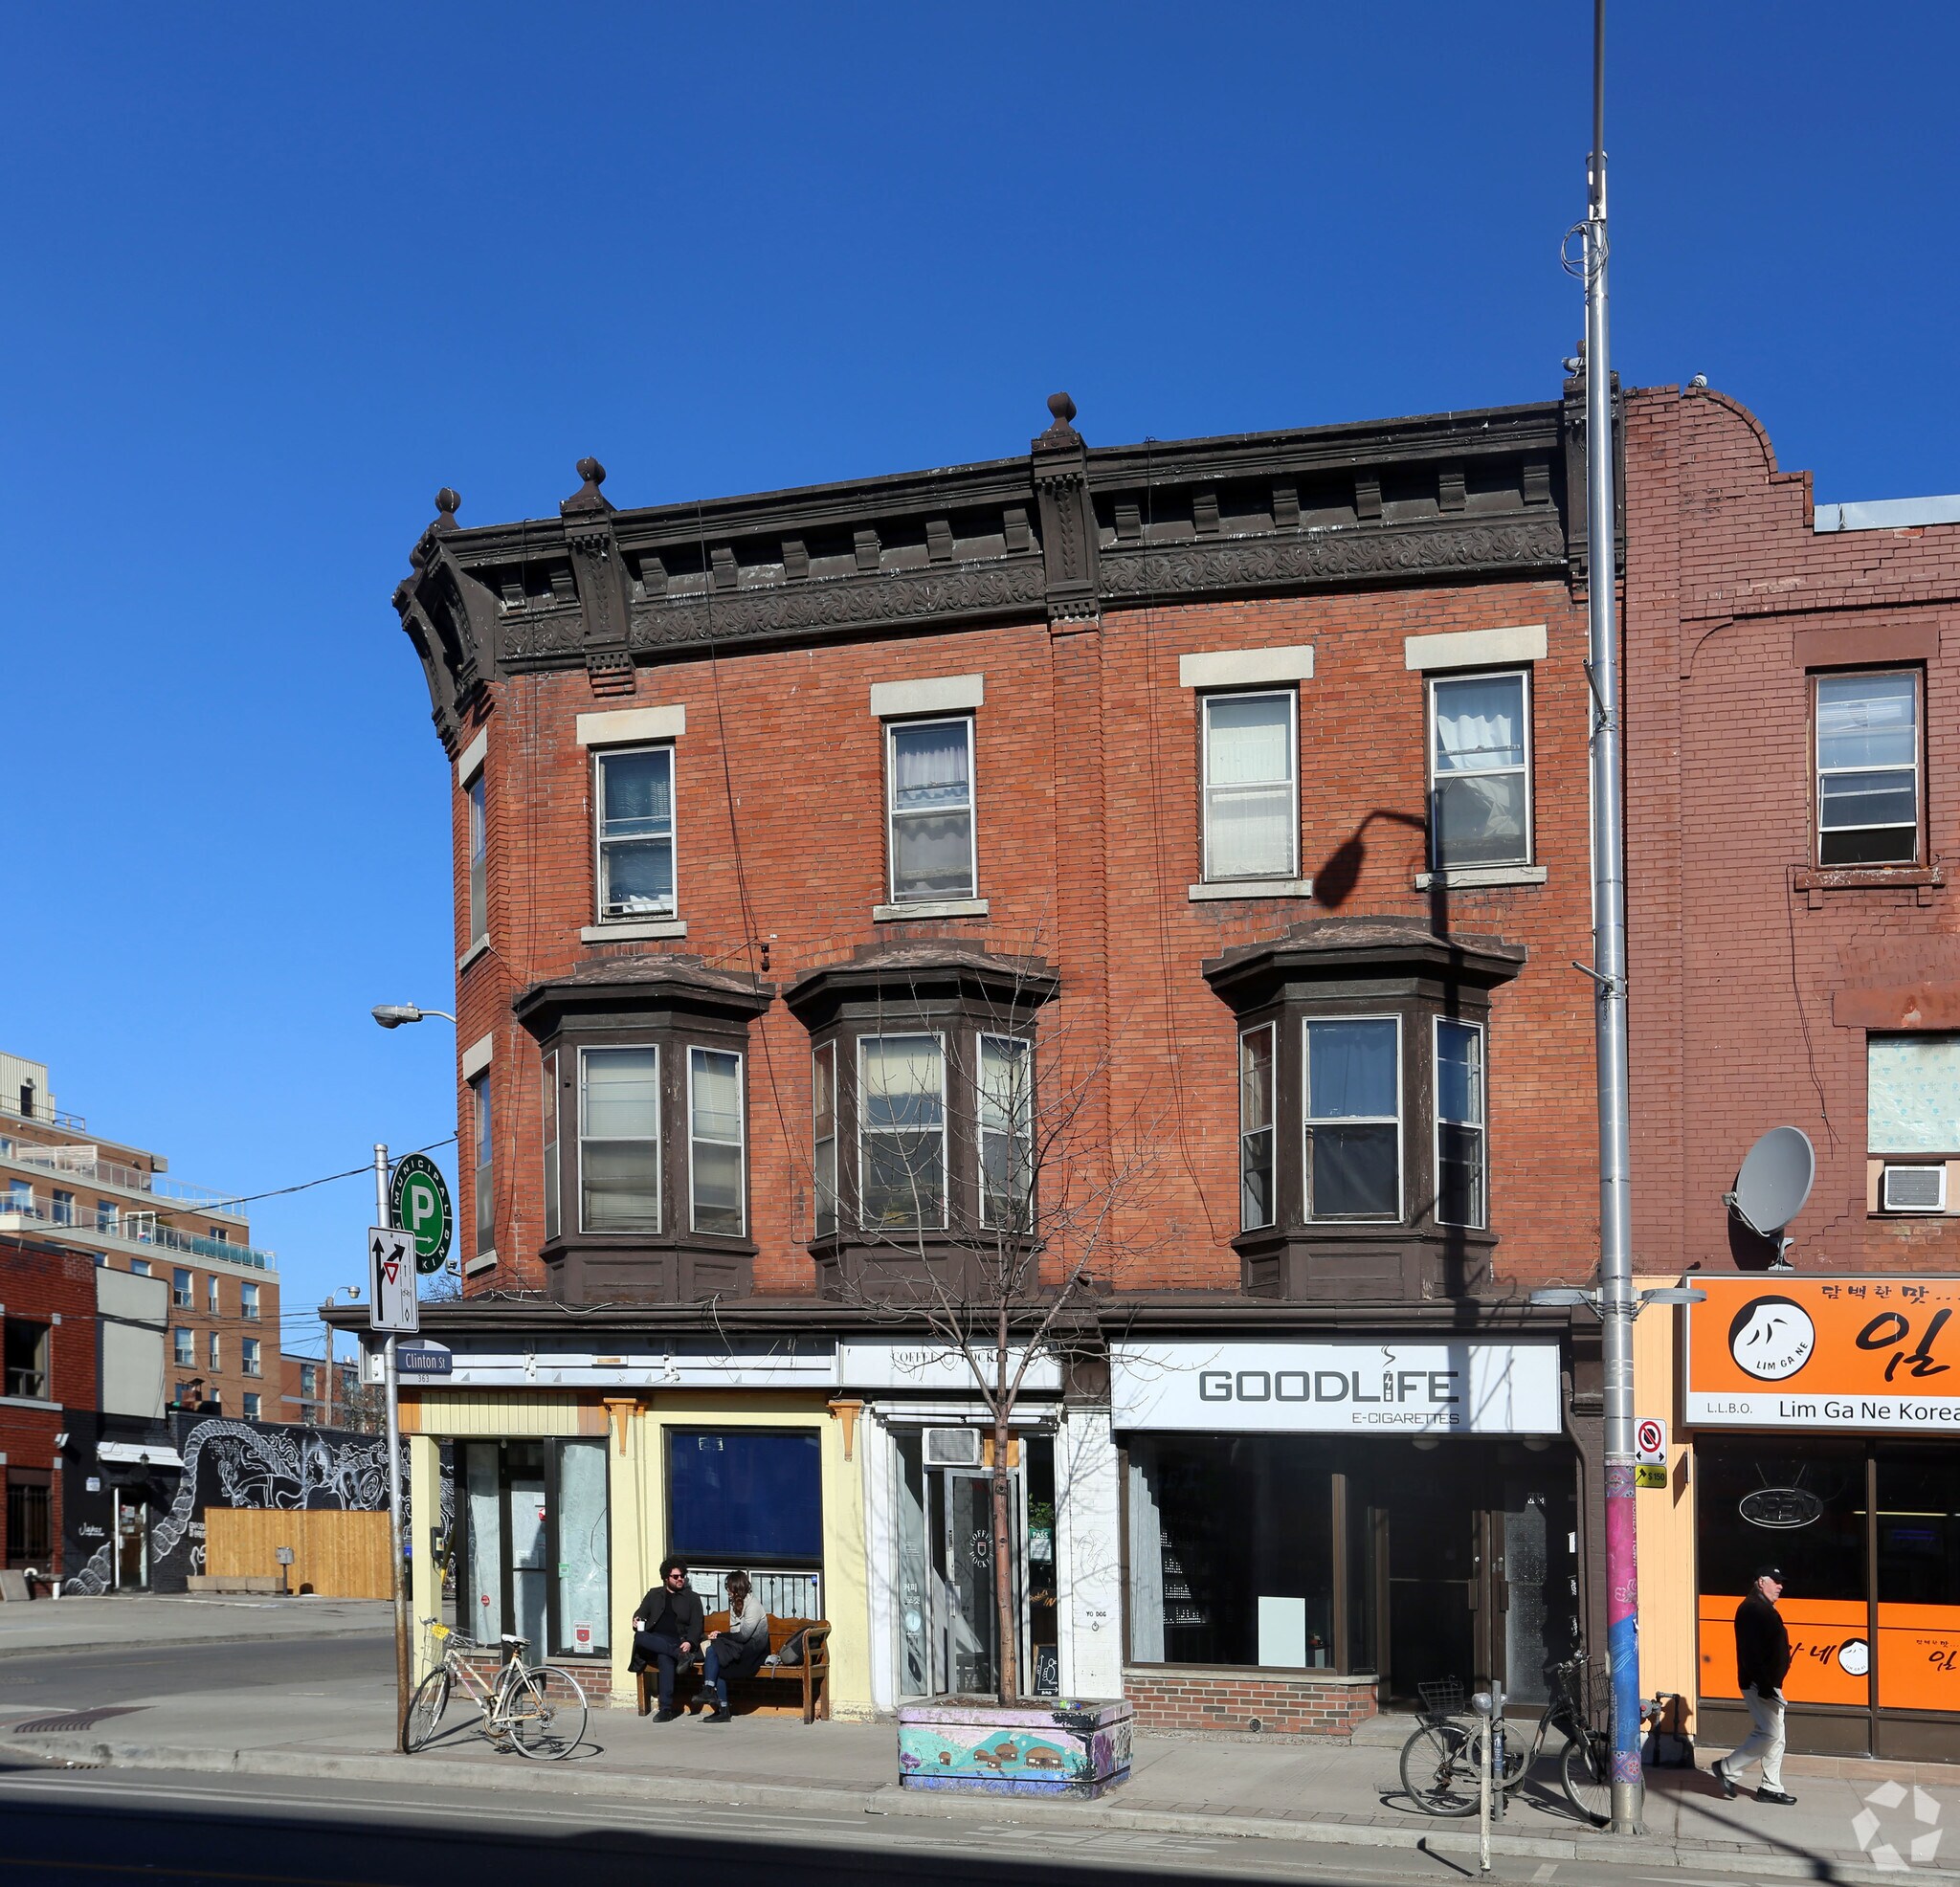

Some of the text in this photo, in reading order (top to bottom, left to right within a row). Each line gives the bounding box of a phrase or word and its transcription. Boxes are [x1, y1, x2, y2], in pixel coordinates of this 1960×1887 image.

[394, 1159, 449, 1210] MUNICIPAL
[412, 1185, 434, 1230] P
[405, 1353, 446, 1369] Clinton St
[1756, 1342, 1809, 1370] LIM GA NE
[417, 1374, 430, 1383] 363
[1199, 1370, 1459, 1403] GOODLIFE
[1351, 1412, 1459, 1425] E-CIGARETTES
[1707, 1402, 1753, 1414] L.L.B.O.
[1779, 1400, 1816, 1418] Lim
[1824, 1401, 1854, 1419] Ga
[1861, 1402, 1891, 1420] Ne
[969, 1529, 994, 1547] COFFEE
